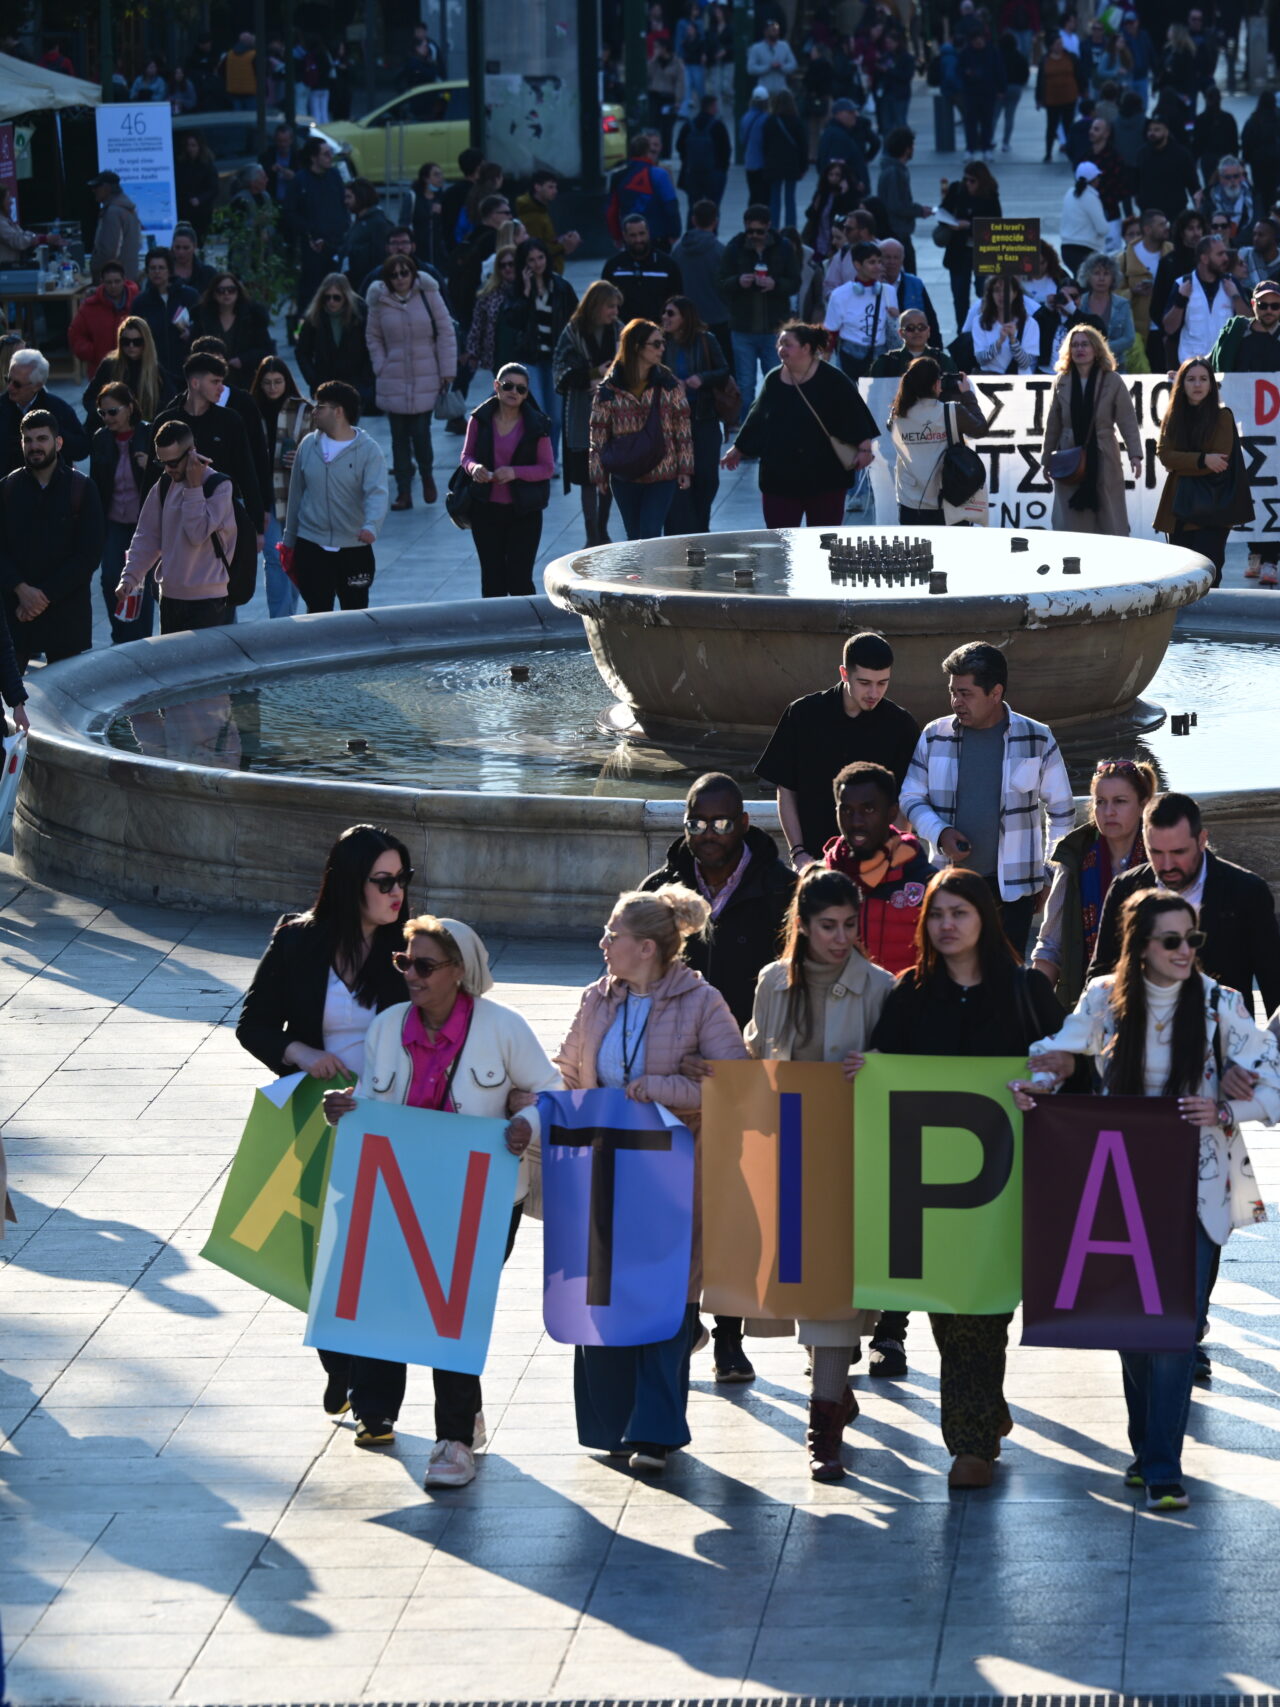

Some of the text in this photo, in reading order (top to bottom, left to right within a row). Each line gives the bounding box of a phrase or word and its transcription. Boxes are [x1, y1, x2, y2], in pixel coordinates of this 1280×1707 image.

[120, 112, 146, 135] 46
[990, 223, 1025, 231] End Israel's
[991, 234, 1024, 243] genocide
[979, 244, 1037, 253] against Palestinians
